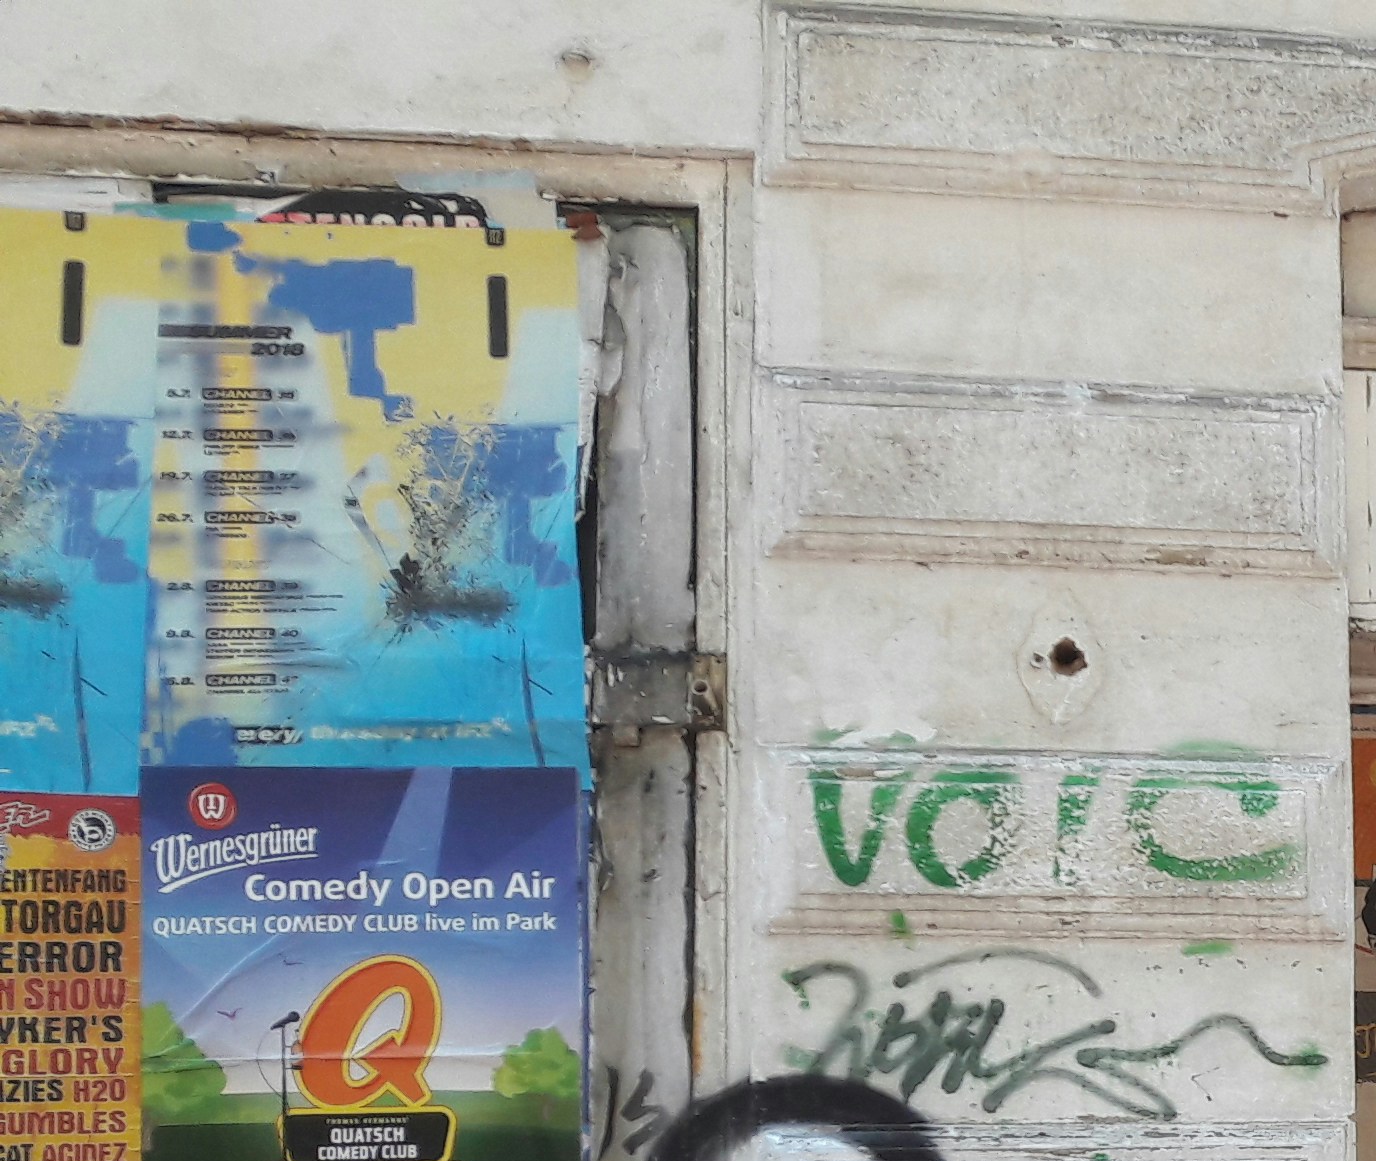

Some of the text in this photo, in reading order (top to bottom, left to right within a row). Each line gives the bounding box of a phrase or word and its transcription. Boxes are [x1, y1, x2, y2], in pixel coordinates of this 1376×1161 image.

[252, 343, 304, 356] 2018
[206, 512, 274, 523] CHANNEL
[206, 629, 275, 639] CHANNEL
[150, 824, 317, 882] Wernesgrüner
[245, 871, 556, 905] Comedy Open Air
[1, 900, 127, 934] TORGAU
[153, 912, 556, 935] QUATSCH COMEDY CLUB live im Park
[24, 978, 127, 1011] SHOW
[1, 1047, 124, 1076] GLORY
[331, 1127, 404, 1144] QUATSCH
[318, 1143, 417, 1161] COMEDY CLUB
